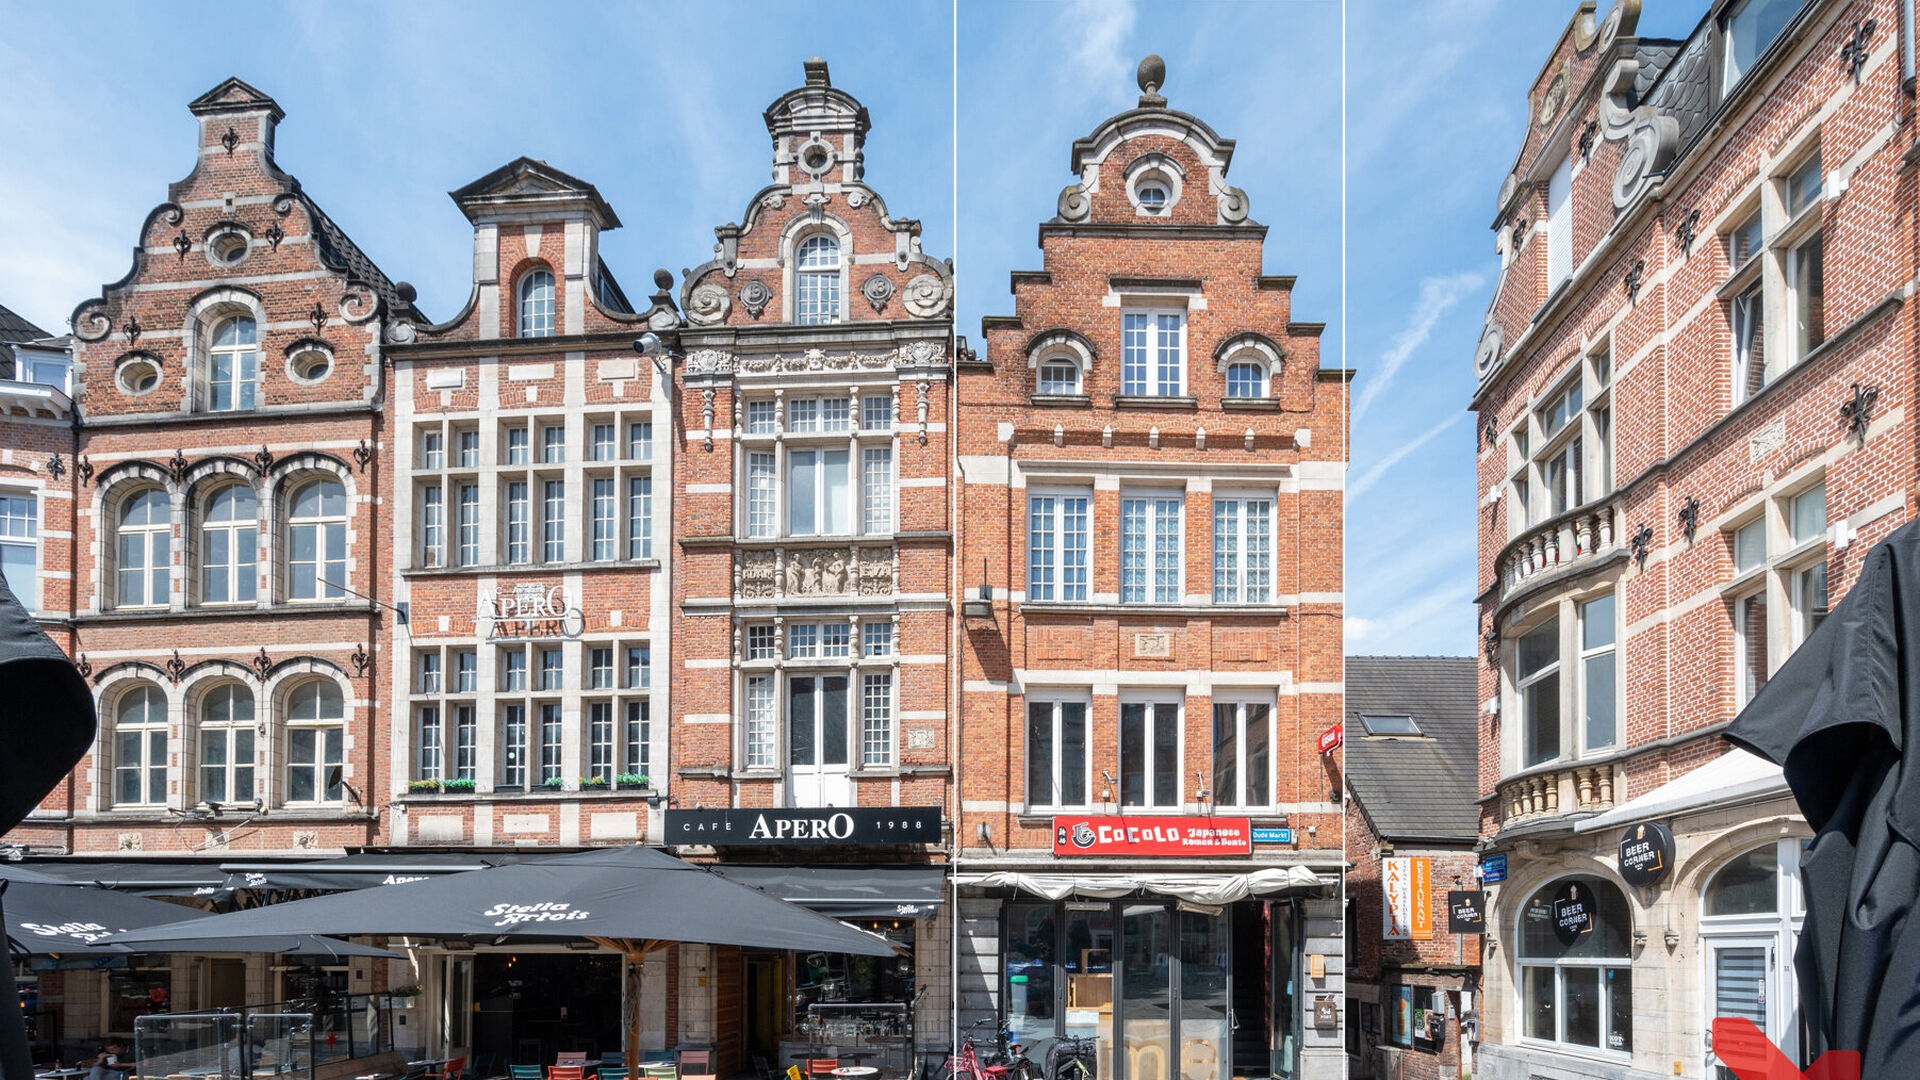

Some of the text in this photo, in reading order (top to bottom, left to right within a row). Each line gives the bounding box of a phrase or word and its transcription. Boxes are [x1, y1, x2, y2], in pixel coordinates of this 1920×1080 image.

[683, 822, 732, 831] CAFE
[876, 821, 922, 830] 1988
[1625, 841, 1650, 857] BEER
[1624, 850, 1655, 867] CORNER
[1387, 860, 1400, 937] KALYPTA
[1416, 860, 1425, 929] RESTAURANT
[484, 902, 570, 916] Stella
[1561, 903, 1583, 917] BEER
[494, 910, 590, 926] Artois
[1559, 913, 1588, 927] CORNER
[20, 922, 107, 936] Stella
